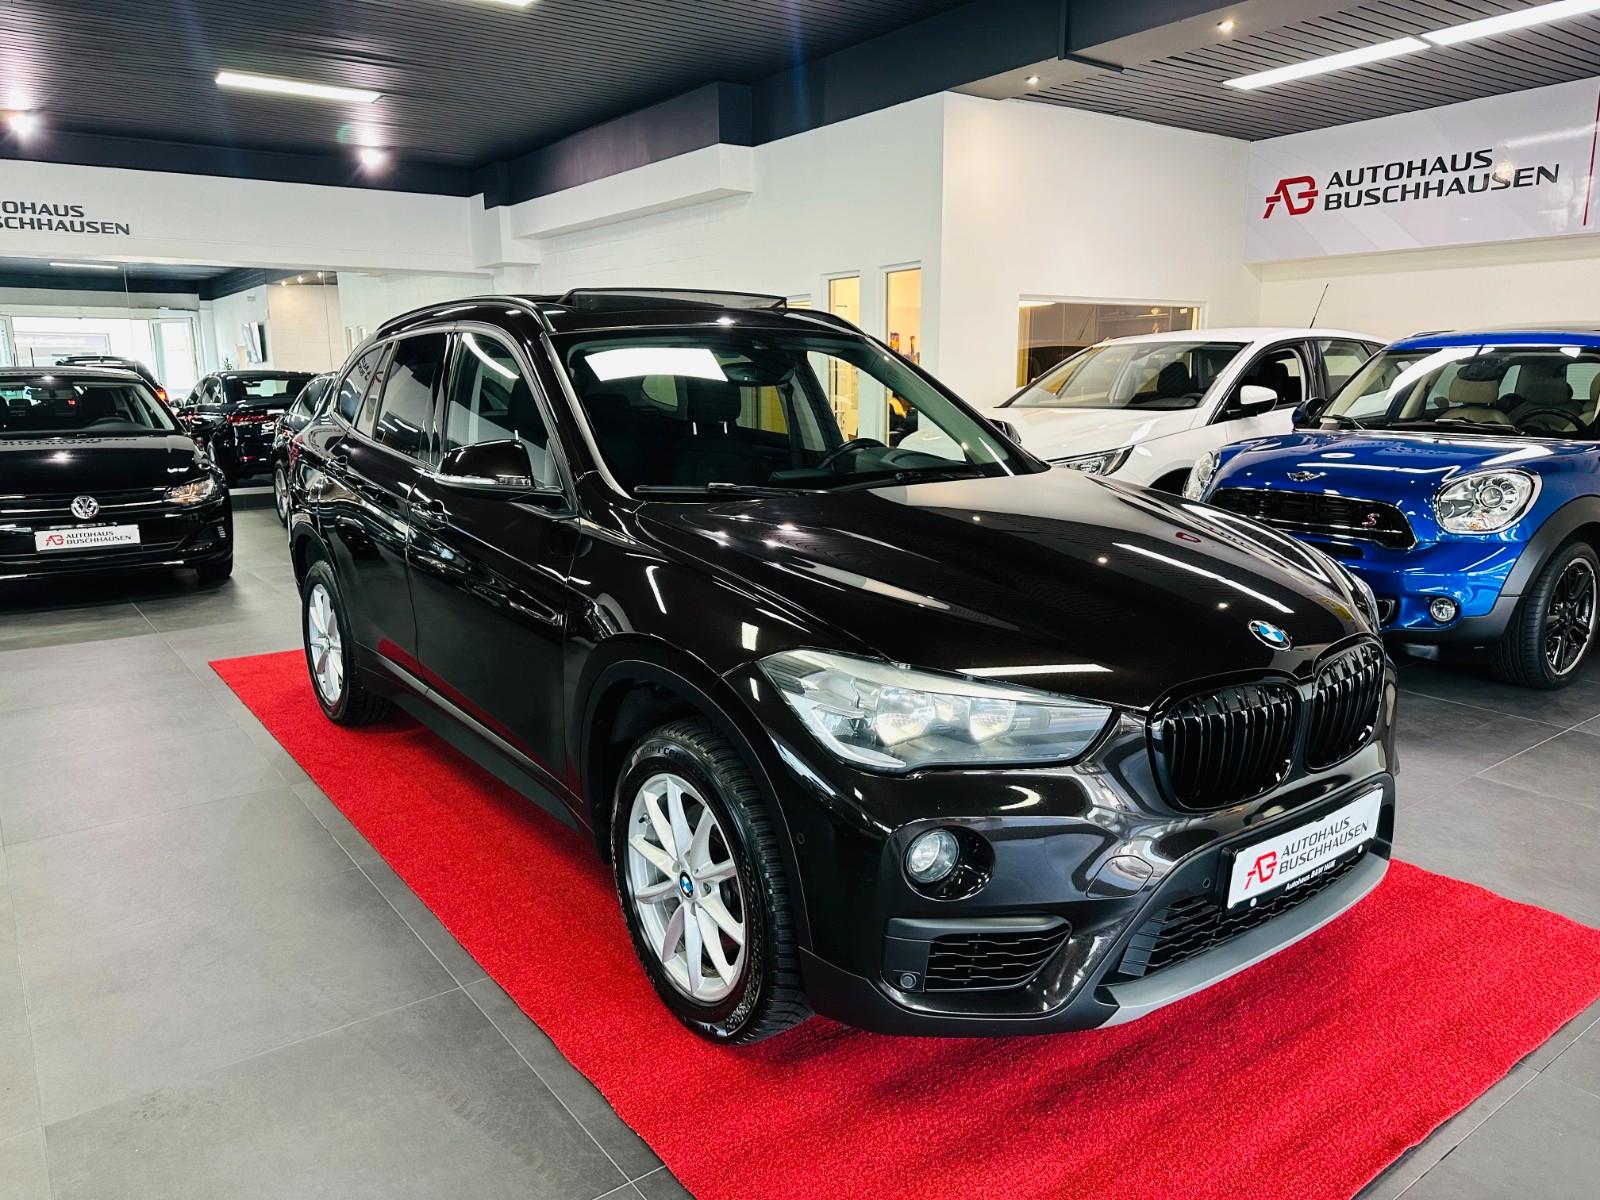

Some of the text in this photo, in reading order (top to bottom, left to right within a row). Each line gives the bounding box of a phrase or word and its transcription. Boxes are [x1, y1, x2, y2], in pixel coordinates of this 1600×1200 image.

[1324, 163, 1560, 212] BUSCHHAUSEN
[1326, 148, 1494, 190] AUTOHAUS
[0, 200, 85, 218] OHAUS
[65, 531, 114, 540] AUTOHAUS
[66, 535, 132, 546] BUSCHHAUSEN
[1278, 820, 1369, 875] BUSCHHAUSEN
[1280, 816, 1351, 861] AUTOHAUS
